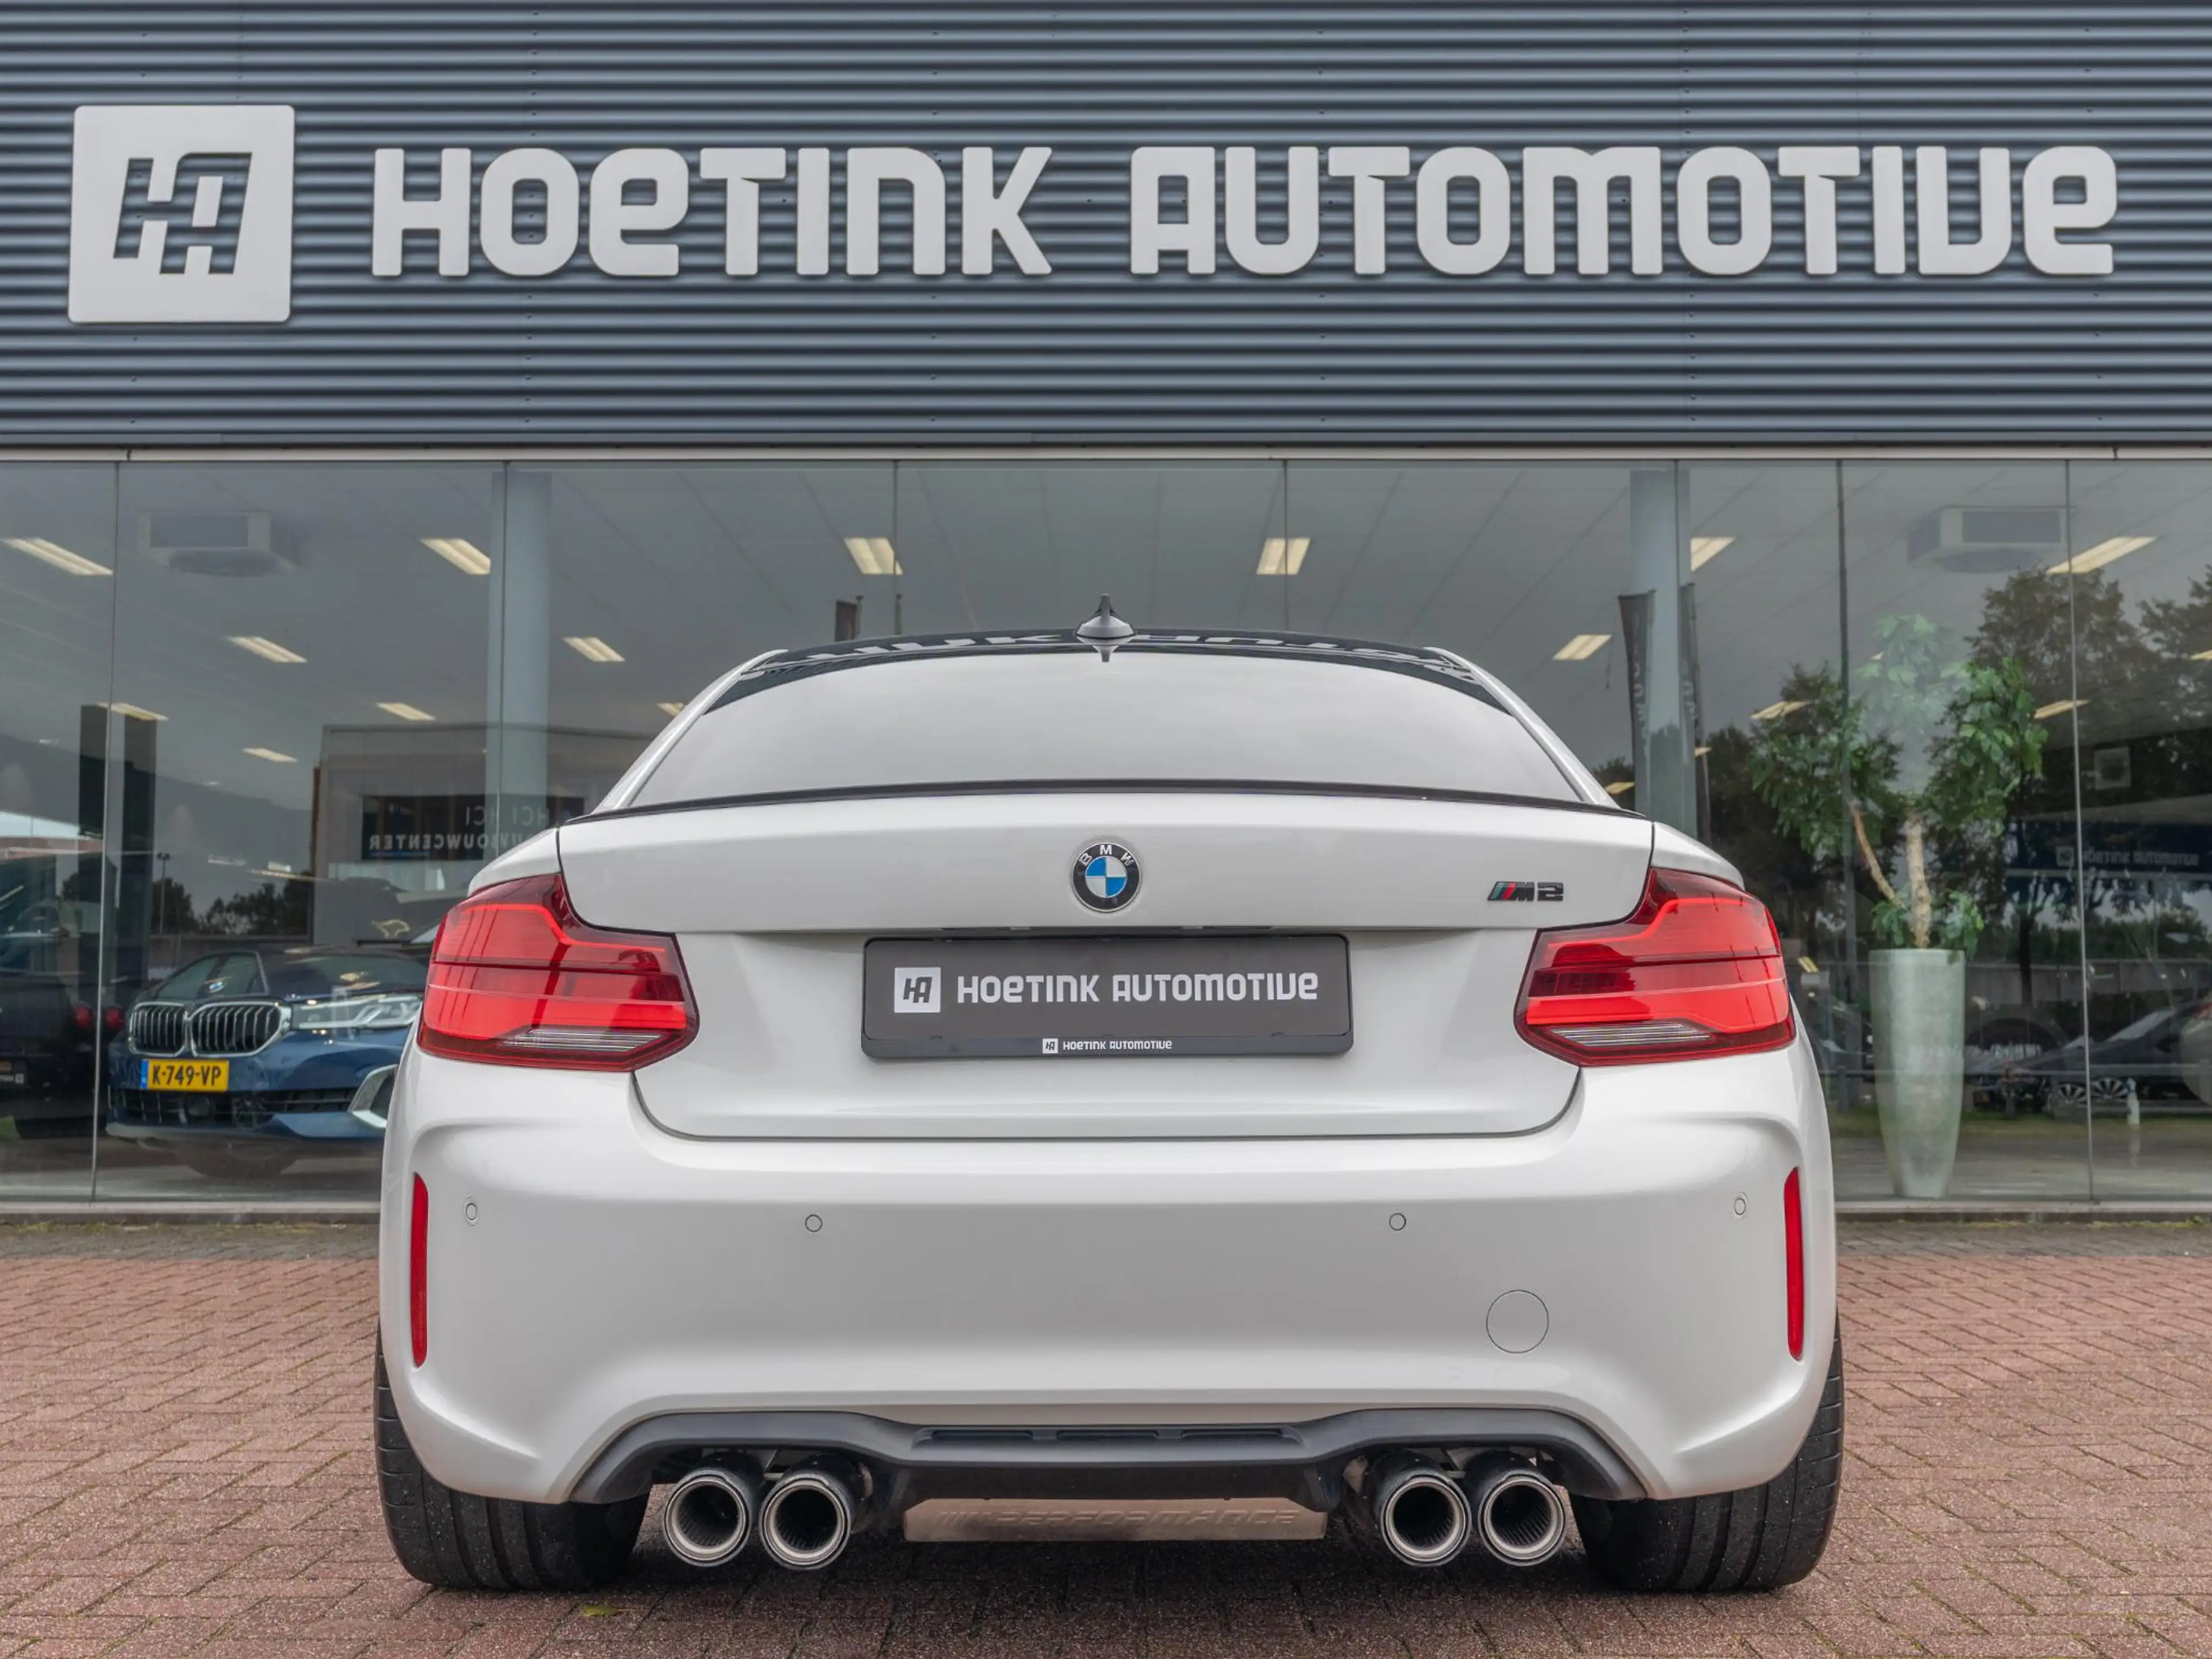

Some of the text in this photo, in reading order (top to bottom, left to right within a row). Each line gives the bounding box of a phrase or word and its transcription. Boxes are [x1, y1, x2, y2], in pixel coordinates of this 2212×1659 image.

[1078, 844, 1135, 866] BMW
[1487, 881, 1563, 902] M2
[152, 1065, 221, 1085] K-749-VP
[995, 1509, 1301, 1525] PERFORMANCE
